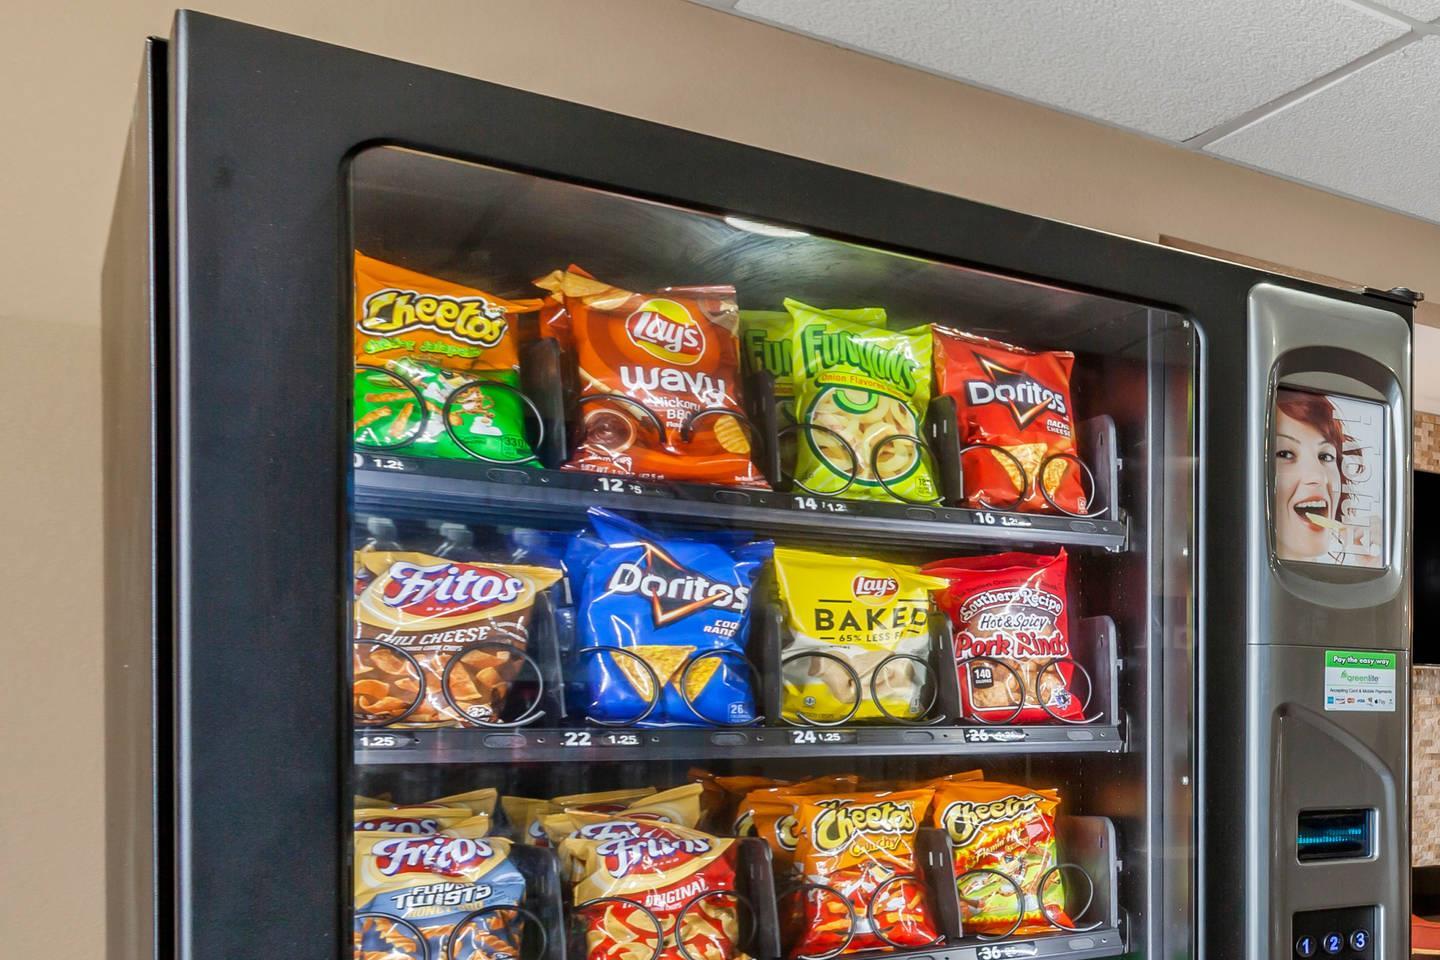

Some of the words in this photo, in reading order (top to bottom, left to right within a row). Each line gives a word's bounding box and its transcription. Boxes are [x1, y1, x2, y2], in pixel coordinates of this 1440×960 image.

[357, 290, 507, 346] Cheetos
[632, 312, 699, 351] Lay's
[620, 366, 726, 408] wavy
[968, 381, 1066, 413] Doritos
[598, 477, 624, 492] 12
[795, 497, 817, 510] 14
[976, 512, 995, 524] 16
[384, 561, 525, 608] Fritos
[608, 562, 750, 610] Doritos
[856, 578, 897, 596] Lay's
[961, 590, 1020, 620] Southern
[1020, 587, 1061, 613] Recipe
[715, 620, 738, 630] COO
[815, 607, 928, 631] BAKED
[420, 626, 492, 645] CHEESE
[956, 632, 1011, 658] Pork
[1333, 656, 1346, 664] Pay
[974, 669, 991, 679] 140
[359, 736, 395, 748] 1.25
[564, 732, 592, 746] 22
[609, 735, 639, 746] 1.25
[793, 731, 816, 743] 24
[814, 800, 915, 852] Cheetos
[373, 837, 494, 876] Fritos
[1303, 939, 1310, 953] 1
[1330, 936, 1338, 951] 2
[1356, 933, 1365, 948] 3
